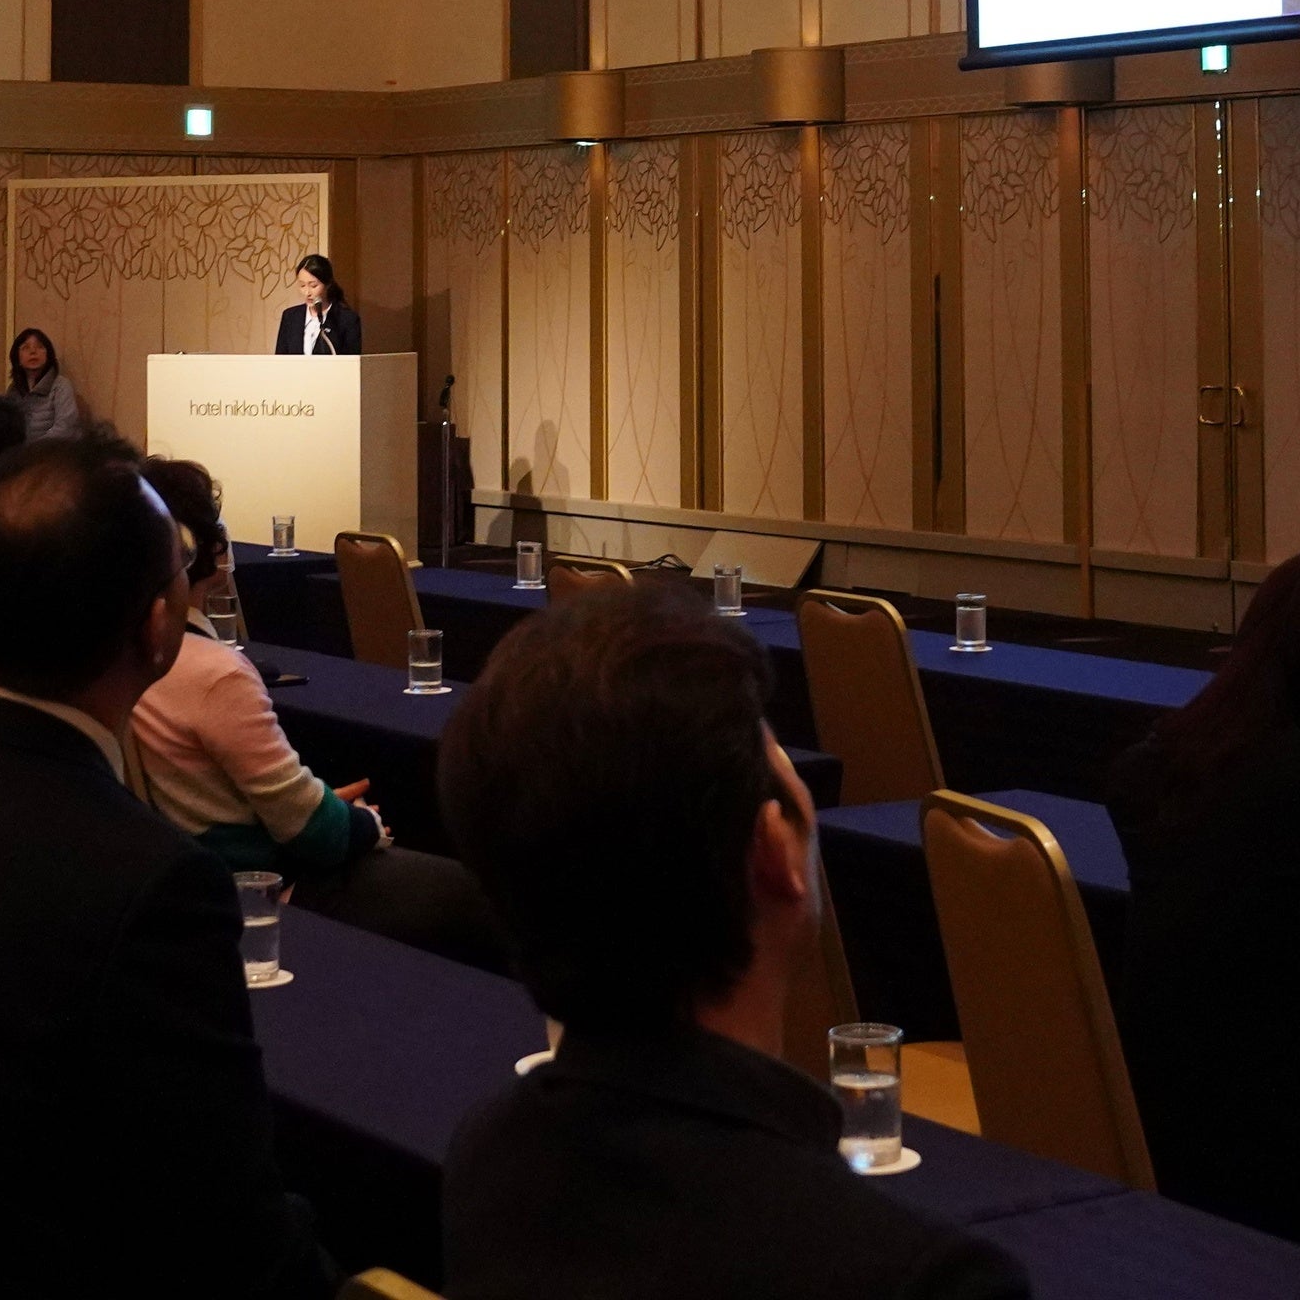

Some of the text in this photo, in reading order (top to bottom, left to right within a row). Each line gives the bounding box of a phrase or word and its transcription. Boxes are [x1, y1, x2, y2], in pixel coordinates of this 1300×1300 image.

[189, 399, 315, 417] hotel nikko fukuoka
